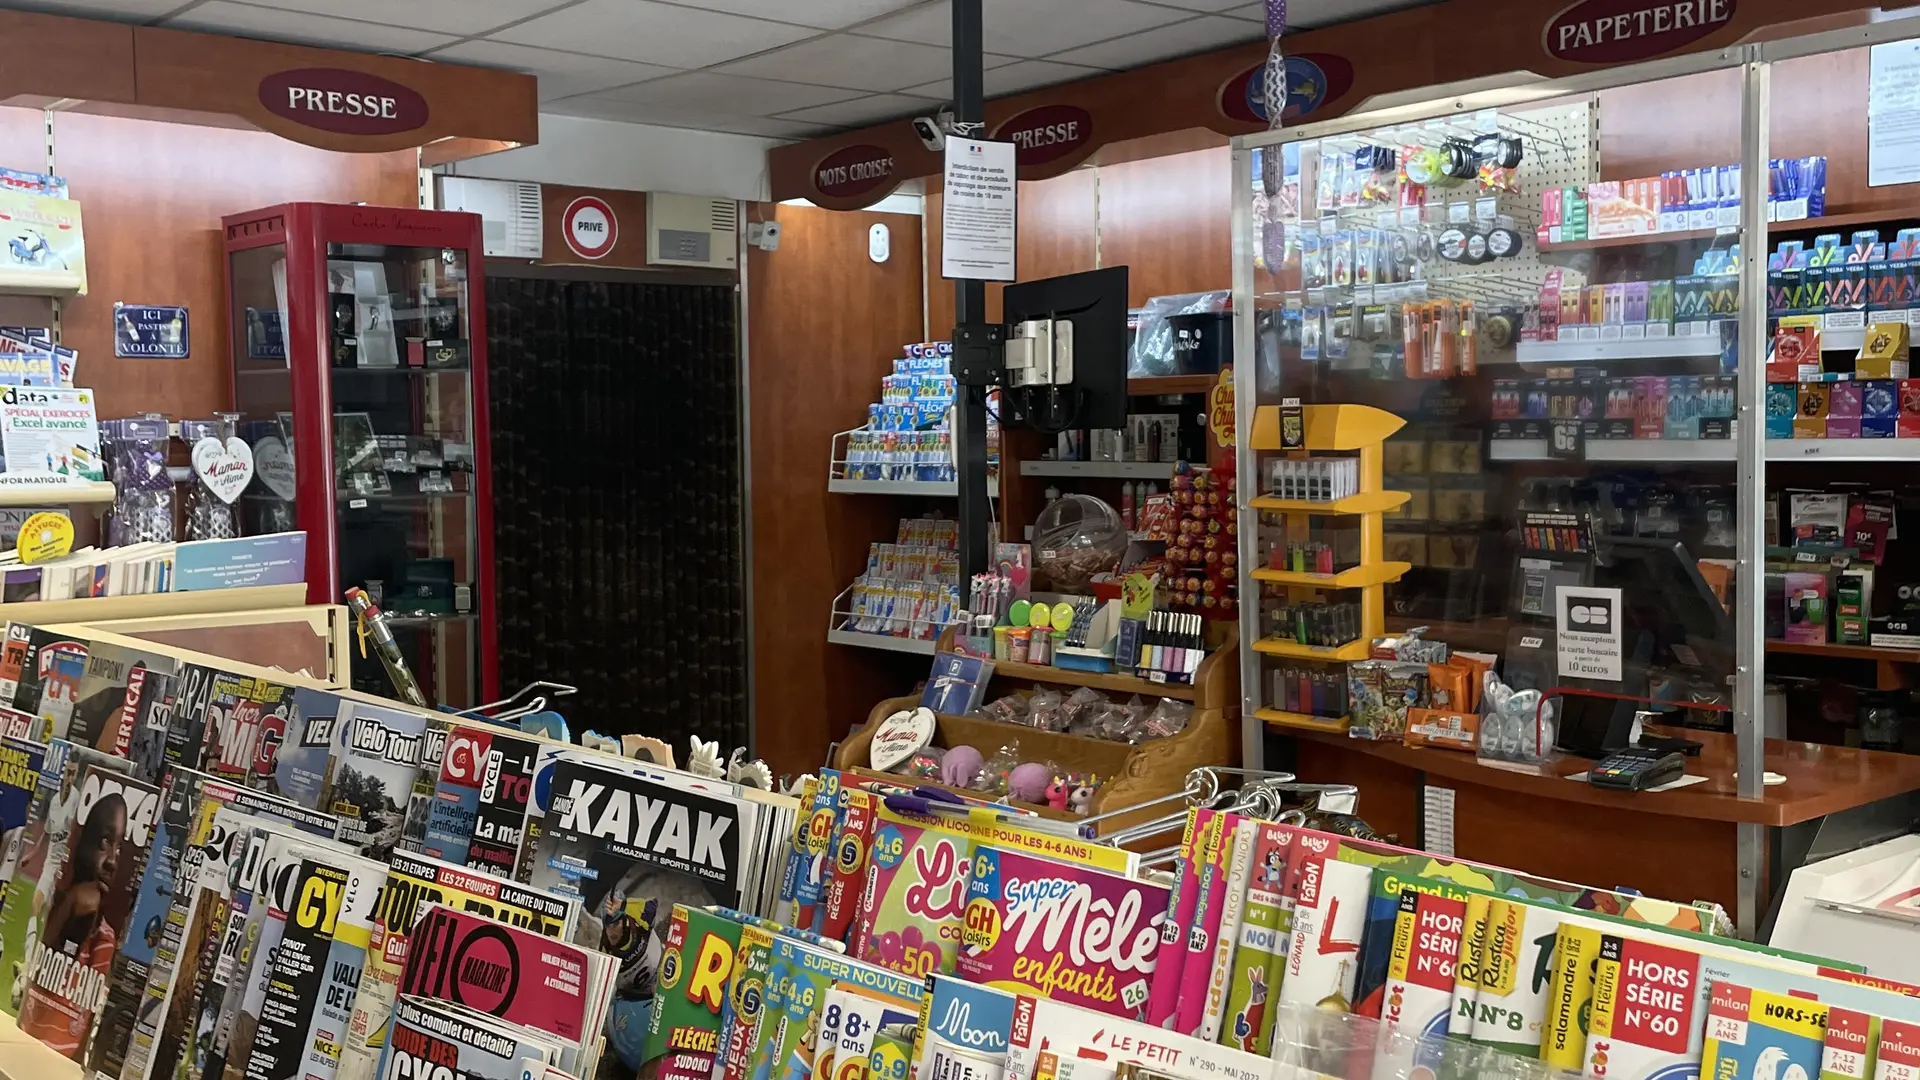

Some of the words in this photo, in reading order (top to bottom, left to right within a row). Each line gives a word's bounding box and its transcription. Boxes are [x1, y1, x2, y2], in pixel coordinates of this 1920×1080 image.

[1557, 0, 1731, 51] PAPETERIE
[288, 86, 398, 119] PRESSE
[1012, 121, 1079, 150] PRESSE
[819, 167, 847, 187] MOTS
[849, 156, 895, 180] CROISES
[952, 162, 979, 172] Interdiction
[143, 310, 161, 319] ICI
[122, 342, 184, 353] VOLONTÉ
[13, 418, 43, 428] Excel
[46, 419, 87, 428] avancé
[204, 460, 248, 477] Maman
[1559, 632, 1578, 641] Nous
[1580, 635, 1616, 645] acceptons
[1567, 646, 1585, 654] carte
[1568, 660, 1579, 671] 10
[1581, 664, 1609, 675] euros
[114, 670, 146, 759] VERTICAL
[353, 719, 386, 750] Vélo
[876, 728, 918, 744] Maman
[483, 752, 501, 802] CYCLE
[323, 817, 336, 830] VMA
[475, 815, 493, 839] La
[559, 778, 733, 871] KAYAK
[1184, 809, 1197, 844] bayard
[1211, 813, 1224, 850] bayard
[947, 821, 991, 839] LICORNE
[993, 830, 1022, 845] POUR
[1024, 836, 1042, 849] LES
[1044, 840, 1061, 852] 4-6
[1063, 845, 1087, 858] ANS
[612, 845, 651, 862] MAGAZINE
[660, 857, 690, 871] SPORTS
[391, 857, 402, 869] LES
[402, 860, 409, 871] 21
[409, 862, 436, 880] ETAPES
[699, 868, 727, 881] PAGAIE
[975, 855, 995, 879] 6+
[439, 871, 453, 884] LES
[454, 875, 465, 887] 22
[465, 877, 497, 897] EQUIPES
[971, 879, 989, 895] ans
[1005, 878, 1077, 912] Super
[501, 888, 510, 900] LA
[511, 891, 533, 907] CARTE
[533, 897, 543, 910] DU
[544, 900, 565, 916] TOUR
[966, 904, 993, 931] GH
[1299, 921, 1313, 932] ans
[1300, 909, 1310, 920] dès
[281, 938, 307, 952] PINOT
[963, 925, 992, 947] Loisirs
[1163, 933, 1176, 943] ANS
[1190, 940, 1204, 951] ANS
[1394, 916, 1412, 960] Fleurus
[1482, 924, 1506, 989] Rustica
[1502, 905, 1517, 966] junior
[292, 951, 312, 963] ENVIE
[902, 948, 934, 976] 50
[1460, 920, 1488, 982] Rustica
[275, 964, 282, 972] LE
[300, 962, 314, 973] SUR
[460, 956, 510, 995] MAGAZINE
[803, 953, 850, 978] SUPER
[852, 969, 922, 1000] NOUVELL
[1012, 951, 1118, 1003] enfants
[1628, 958, 1690, 989] HORS
[1705, 967, 1730, 979] Février
[326, 985, 342, 1009] DE
[1124, 986, 1145, 1004] 26
[1595, 964, 1616, 1013] Fleurus
[1625, 982, 1684, 1013] SÉRIE
[1712, 989, 1749, 1012] milan
[1555, 957, 1578, 1051] salamandre
[845, 1012, 871, 1038] 8+
[936, 996, 1006, 1048] Mon
[1480, 1003, 1523, 1031] N°8
[1624, 1008, 1679, 1037] N°60
[1716, 1019, 1739, 1031] 7-12
[401, 1003, 420, 1026] plus
[420, 1011, 462, 1040] complet
[462, 1025, 473, 1041] et
[474, 1029, 515, 1059] détaillé
[1715, 1029, 1738, 1041] ANS
[1828, 1019, 1867, 1045] milan
[314, 1039, 332, 1054] NICE
[431, 1035, 458, 1068] DES
[841, 1038, 865, 1054] ans
[1012, 1049, 1022, 1060] dès
[1110, 1034, 1130, 1052] LE
[1137, 1040, 1182, 1066] PETIT
[1200, 1059, 1216, 1073] 290
[1224, 1066, 1238, 1079] MAI
[1881, 1032, 1920, 1057] milan
[674, 1054, 711, 1073] SUDOKU
[1013, 1060, 1025, 1073] ans
[1830, 1062, 1855, 1074] ANS
[1832, 1052, 1856, 1064] 7-12
[1886, 1065, 1910, 1077] 7-12
